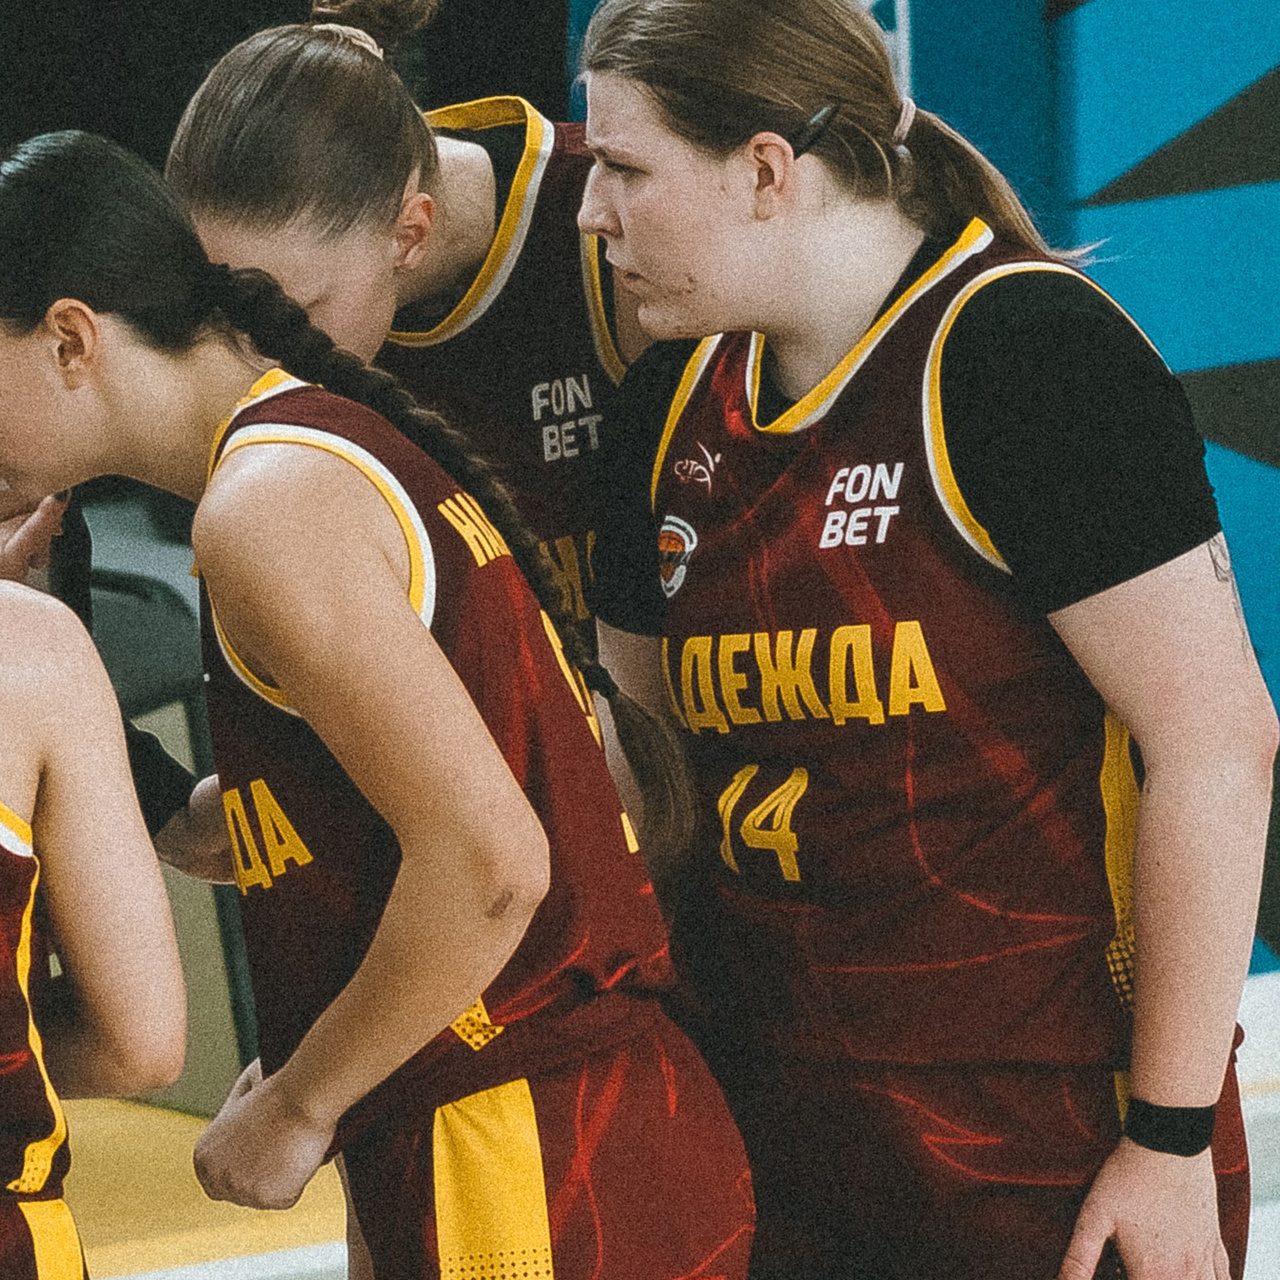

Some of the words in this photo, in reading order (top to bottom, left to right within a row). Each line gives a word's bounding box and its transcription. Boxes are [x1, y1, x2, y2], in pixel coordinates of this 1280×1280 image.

[531, 373, 592, 422] FON
[542, 413, 603, 462] BET
[826, 462, 905, 506] FON
[820, 506, 899, 548] BET
[662, 620, 947, 735] ДЕЖДА
[718, 764, 809, 882] 14
